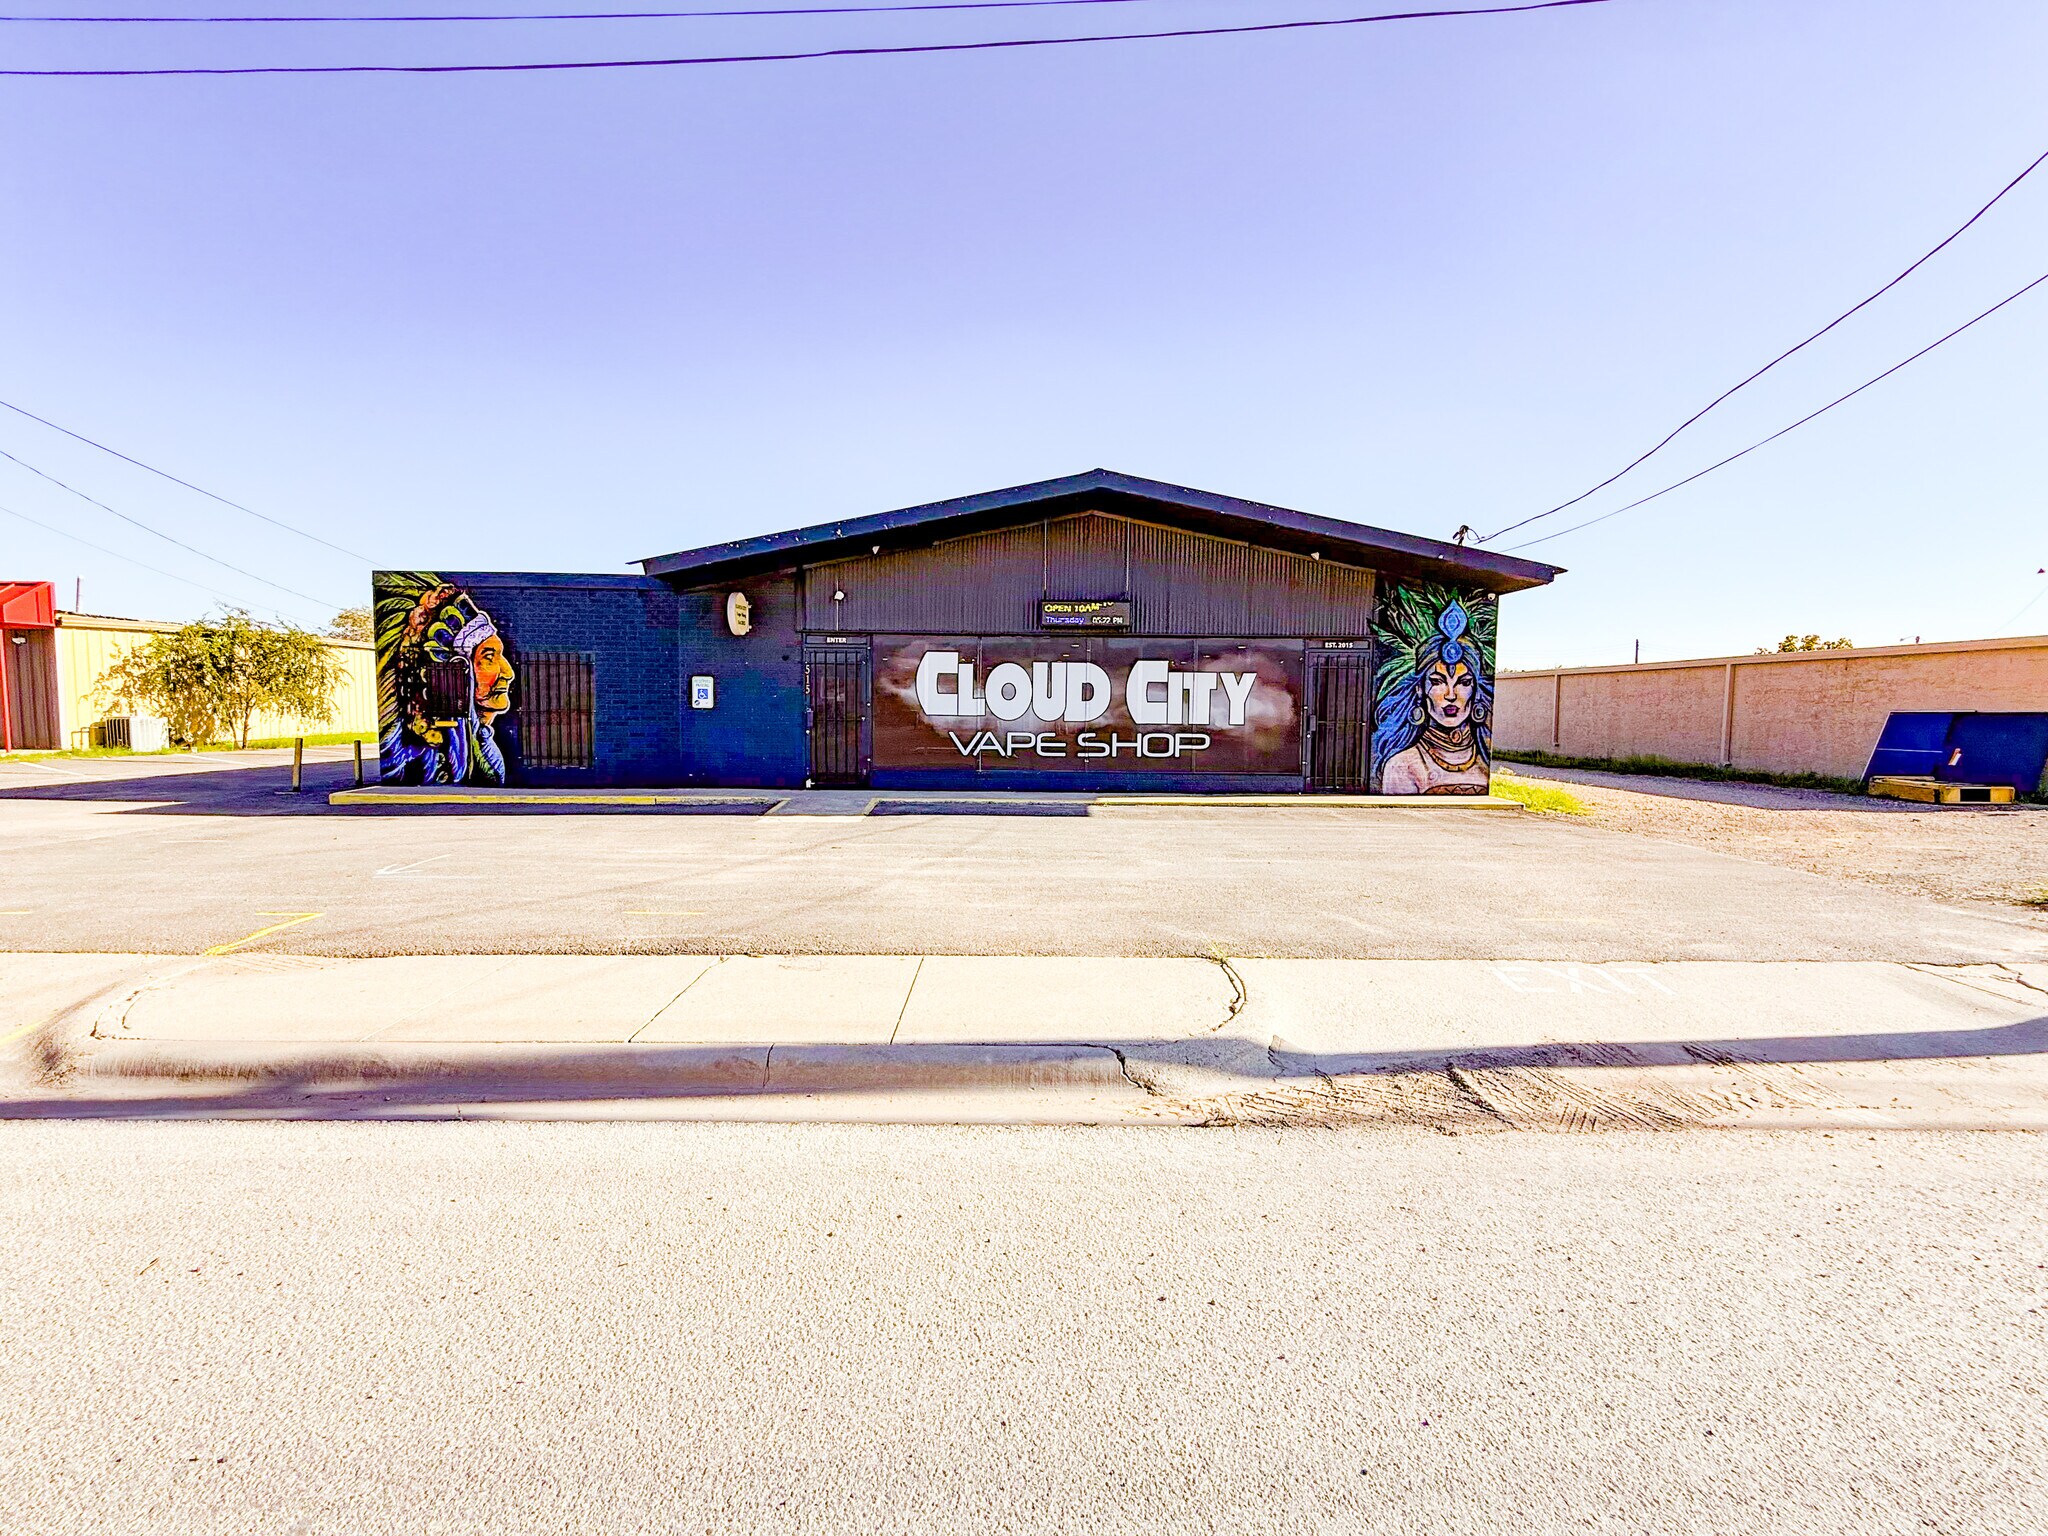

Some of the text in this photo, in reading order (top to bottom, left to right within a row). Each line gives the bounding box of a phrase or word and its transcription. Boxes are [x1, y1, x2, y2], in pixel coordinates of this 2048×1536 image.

[1044, 604, 1072, 612] OPEN
[1045, 616, 1085, 625] Thursday
[1112, 616, 1123, 624] PM
[915, 650, 1258, 725] CLOUD CITY
[948, 730, 1211, 759] VAPE SHOP
[1486, 965, 1679, 997] EXIT
